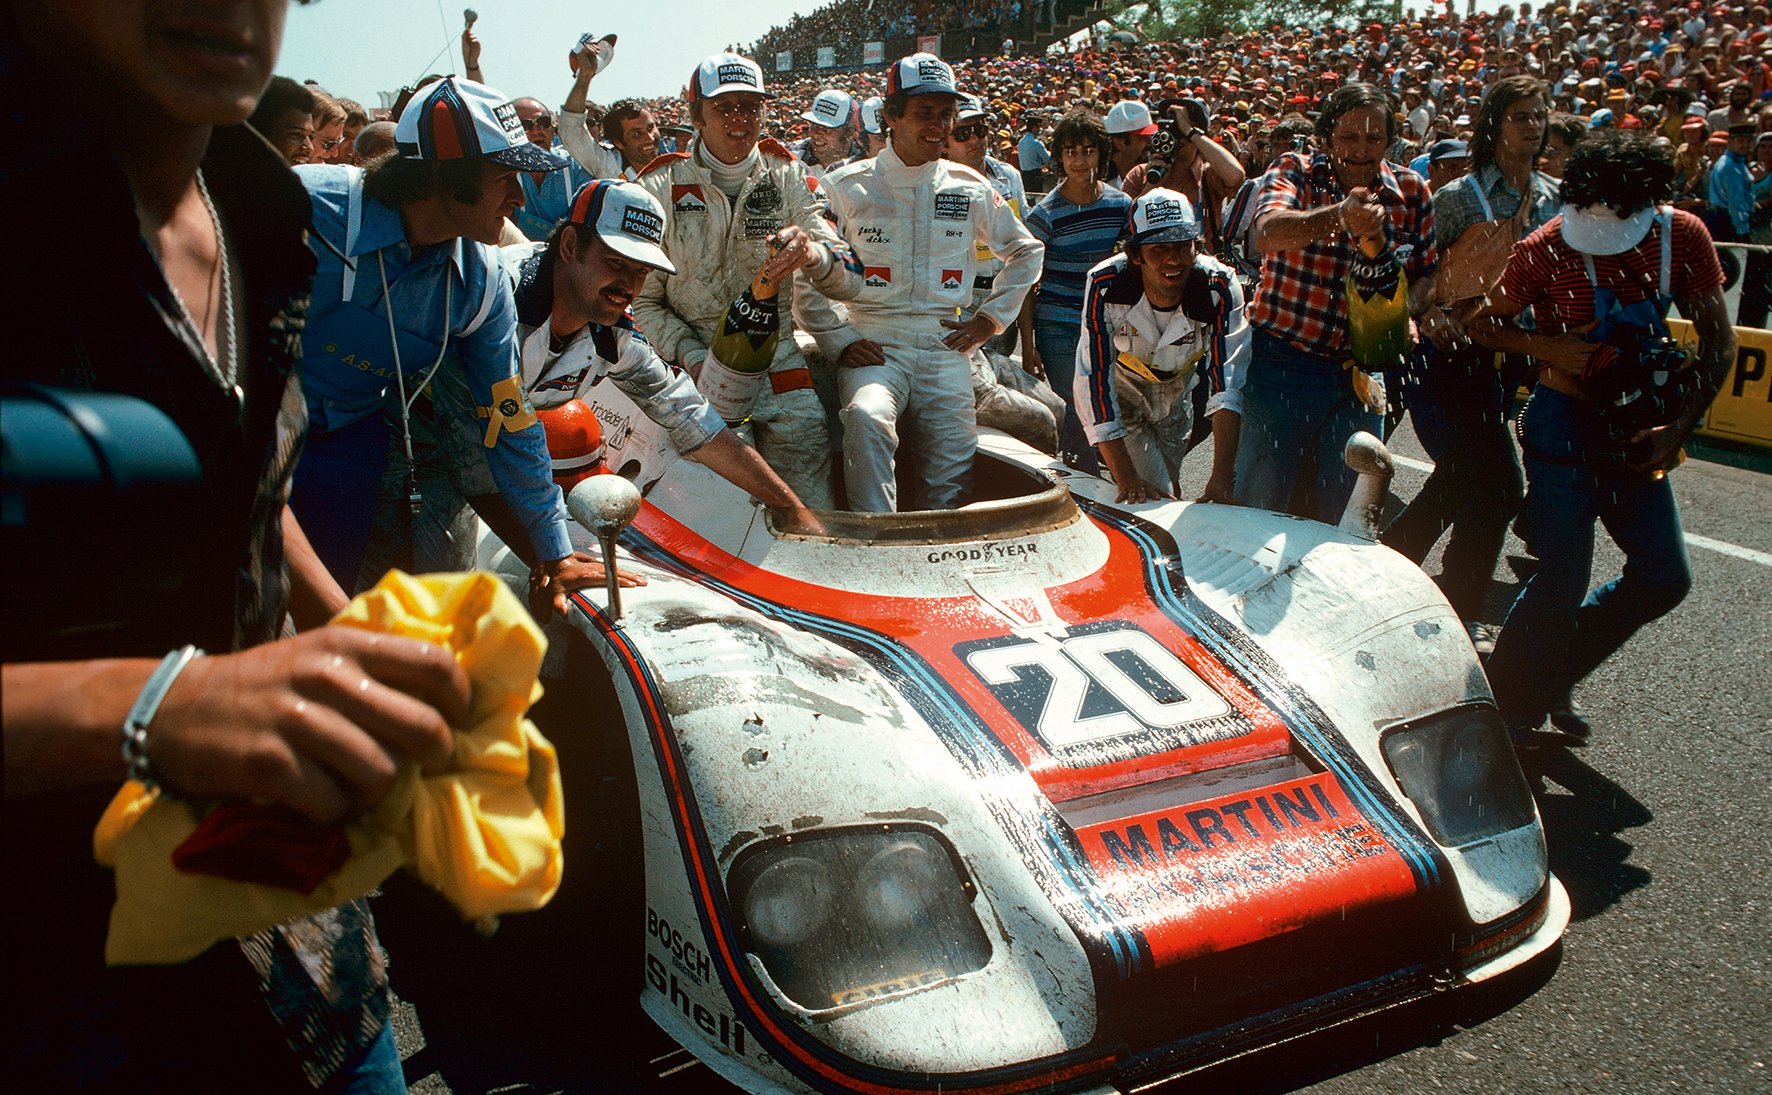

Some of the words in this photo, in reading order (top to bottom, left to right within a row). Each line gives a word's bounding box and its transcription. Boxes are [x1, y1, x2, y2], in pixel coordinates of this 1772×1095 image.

[937, 203, 969, 211] PORSCHE
[966, 629, 1232, 749] 20
[1099, 783, 1340, 872] MARTINI
[1118, 823, 1388, 917] ORSCHE
[647, 905, 711, 984] BOSCH
[647, 952, 745, 1057] Shell
